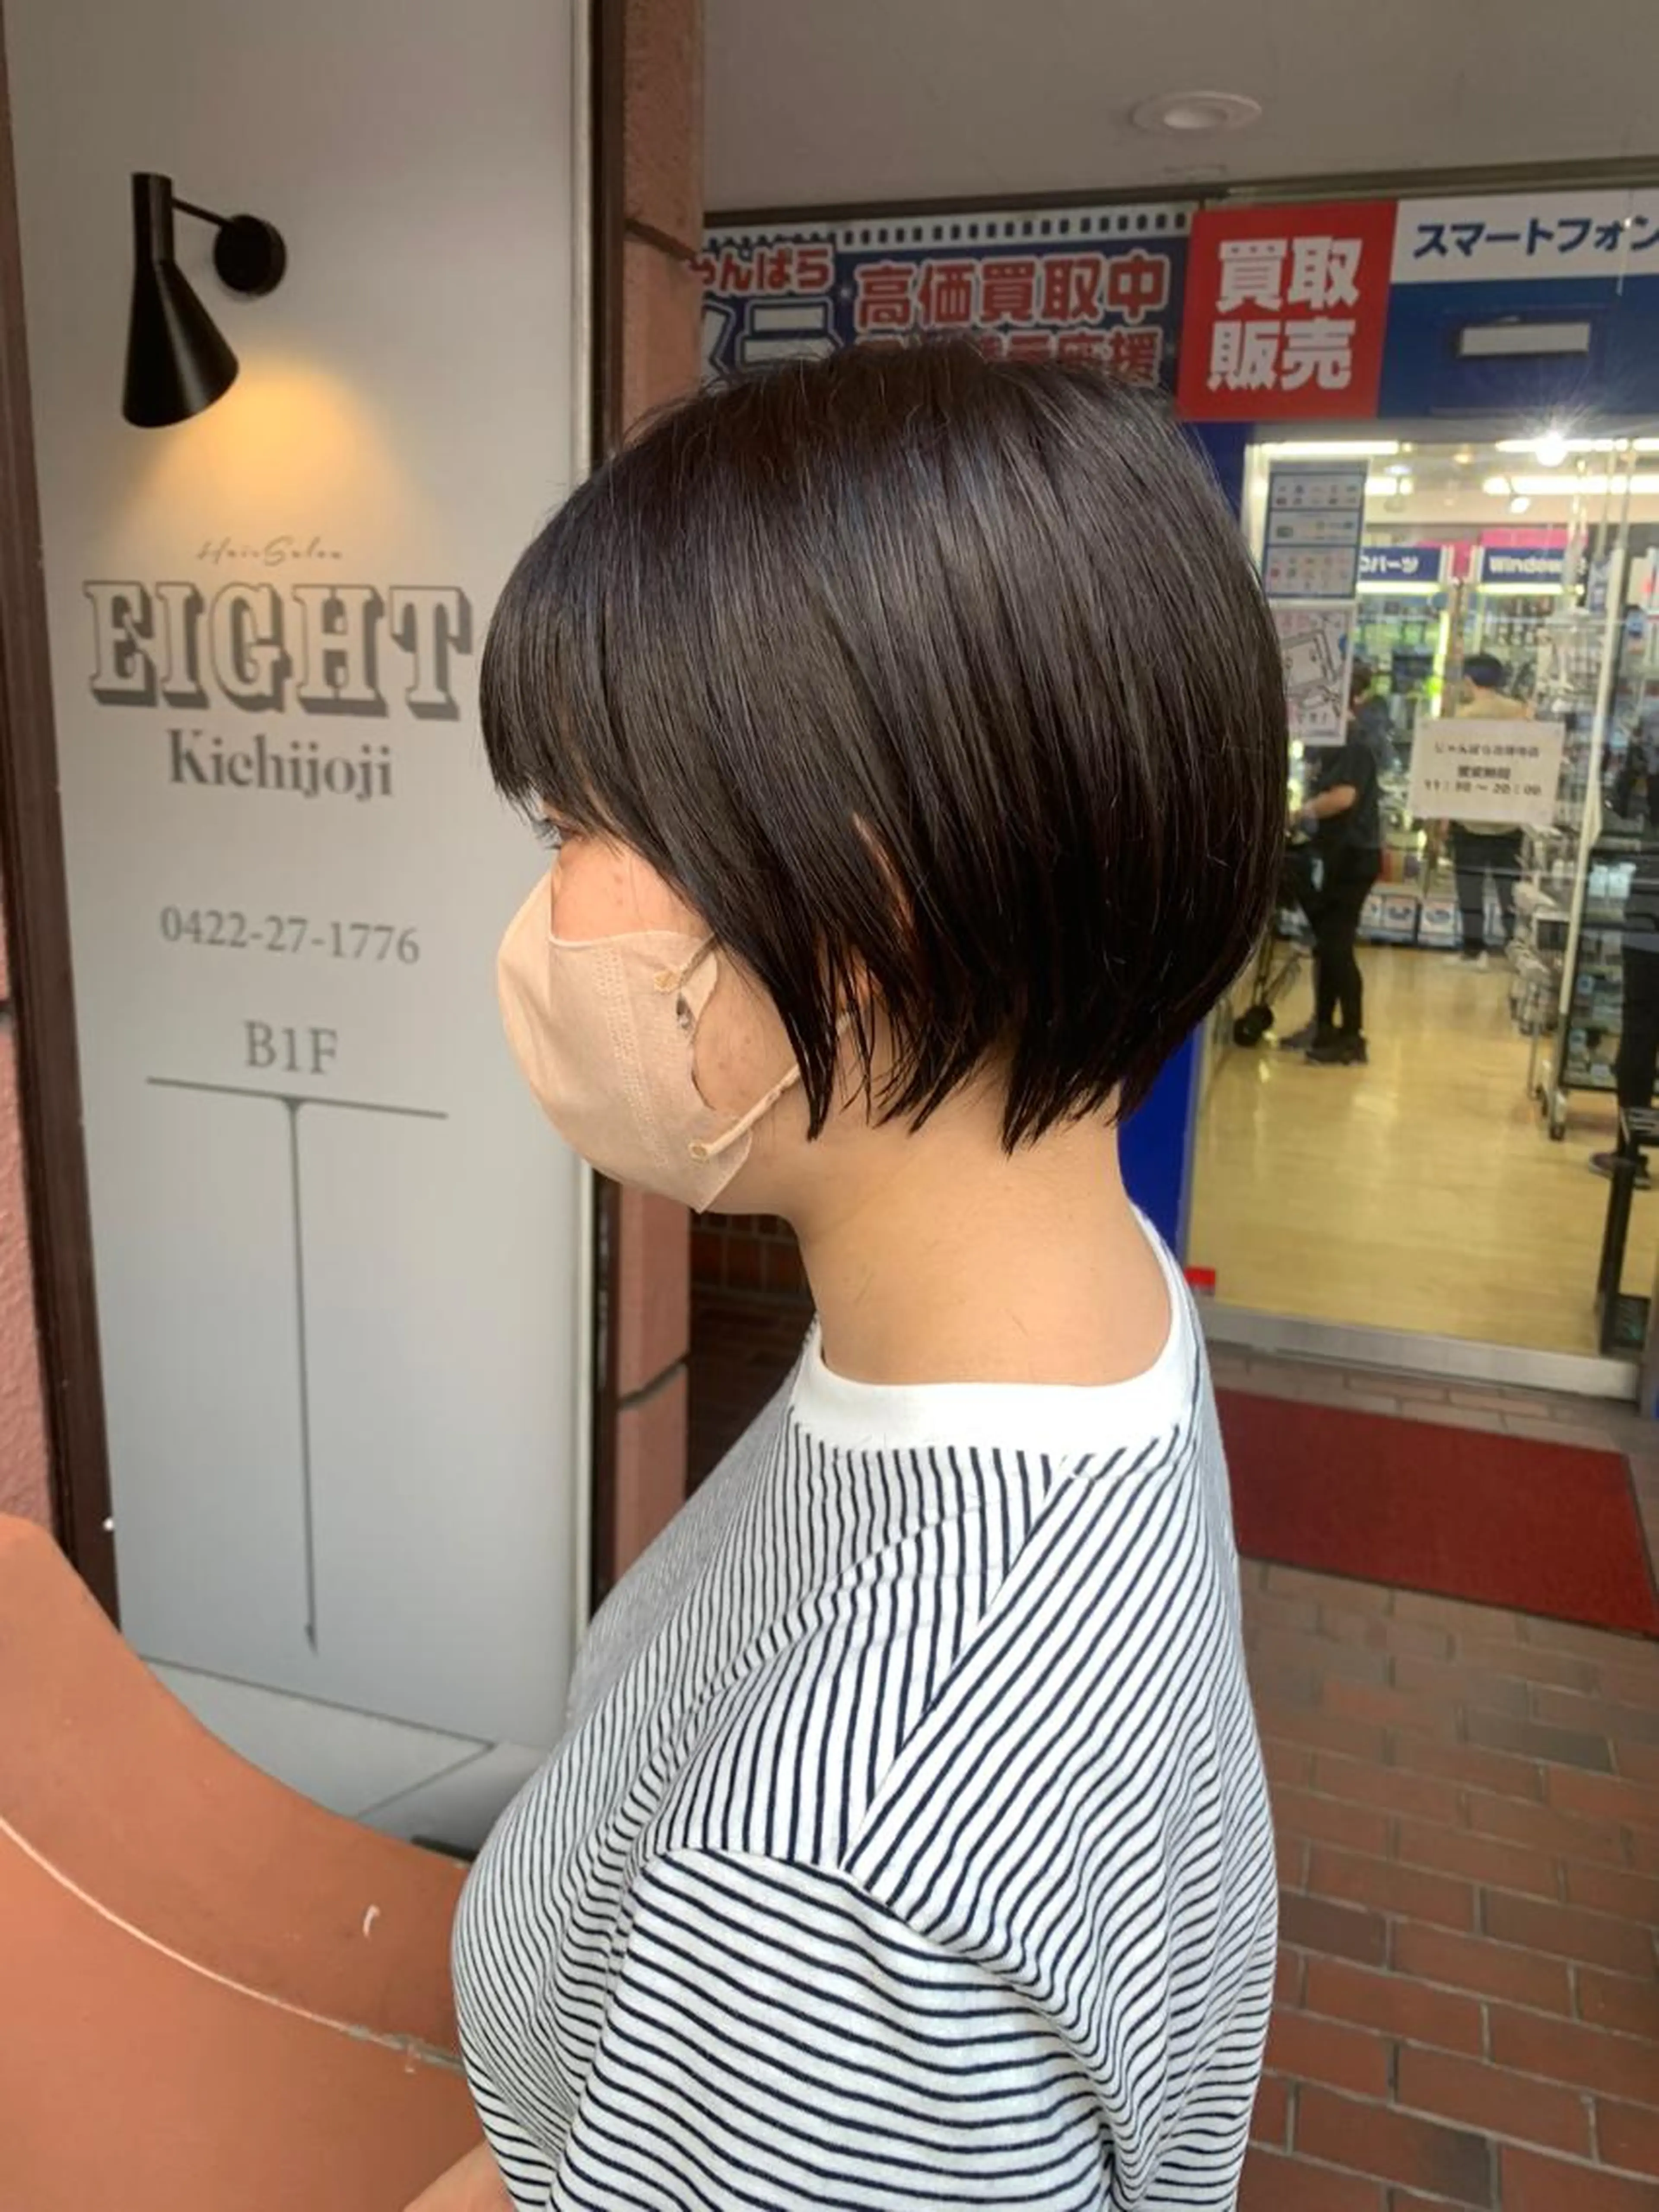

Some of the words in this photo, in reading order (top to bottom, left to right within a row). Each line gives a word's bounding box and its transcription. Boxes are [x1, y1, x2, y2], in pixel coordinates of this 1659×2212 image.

[1217, 235, 1363, 312] 買取
[1413, 215, 1659, 259] スマートフォン
[855, 249, 1169, 330] 高価買取中
[1207, 316, 1356, 392] 販売
[84, 580, 472, 721] EIGHT
[167, 728, 394, 802] Kichijoji
[159, 905, 421, 965] 0422-27-1776
[244, 1020, 339, 1076] B1F
